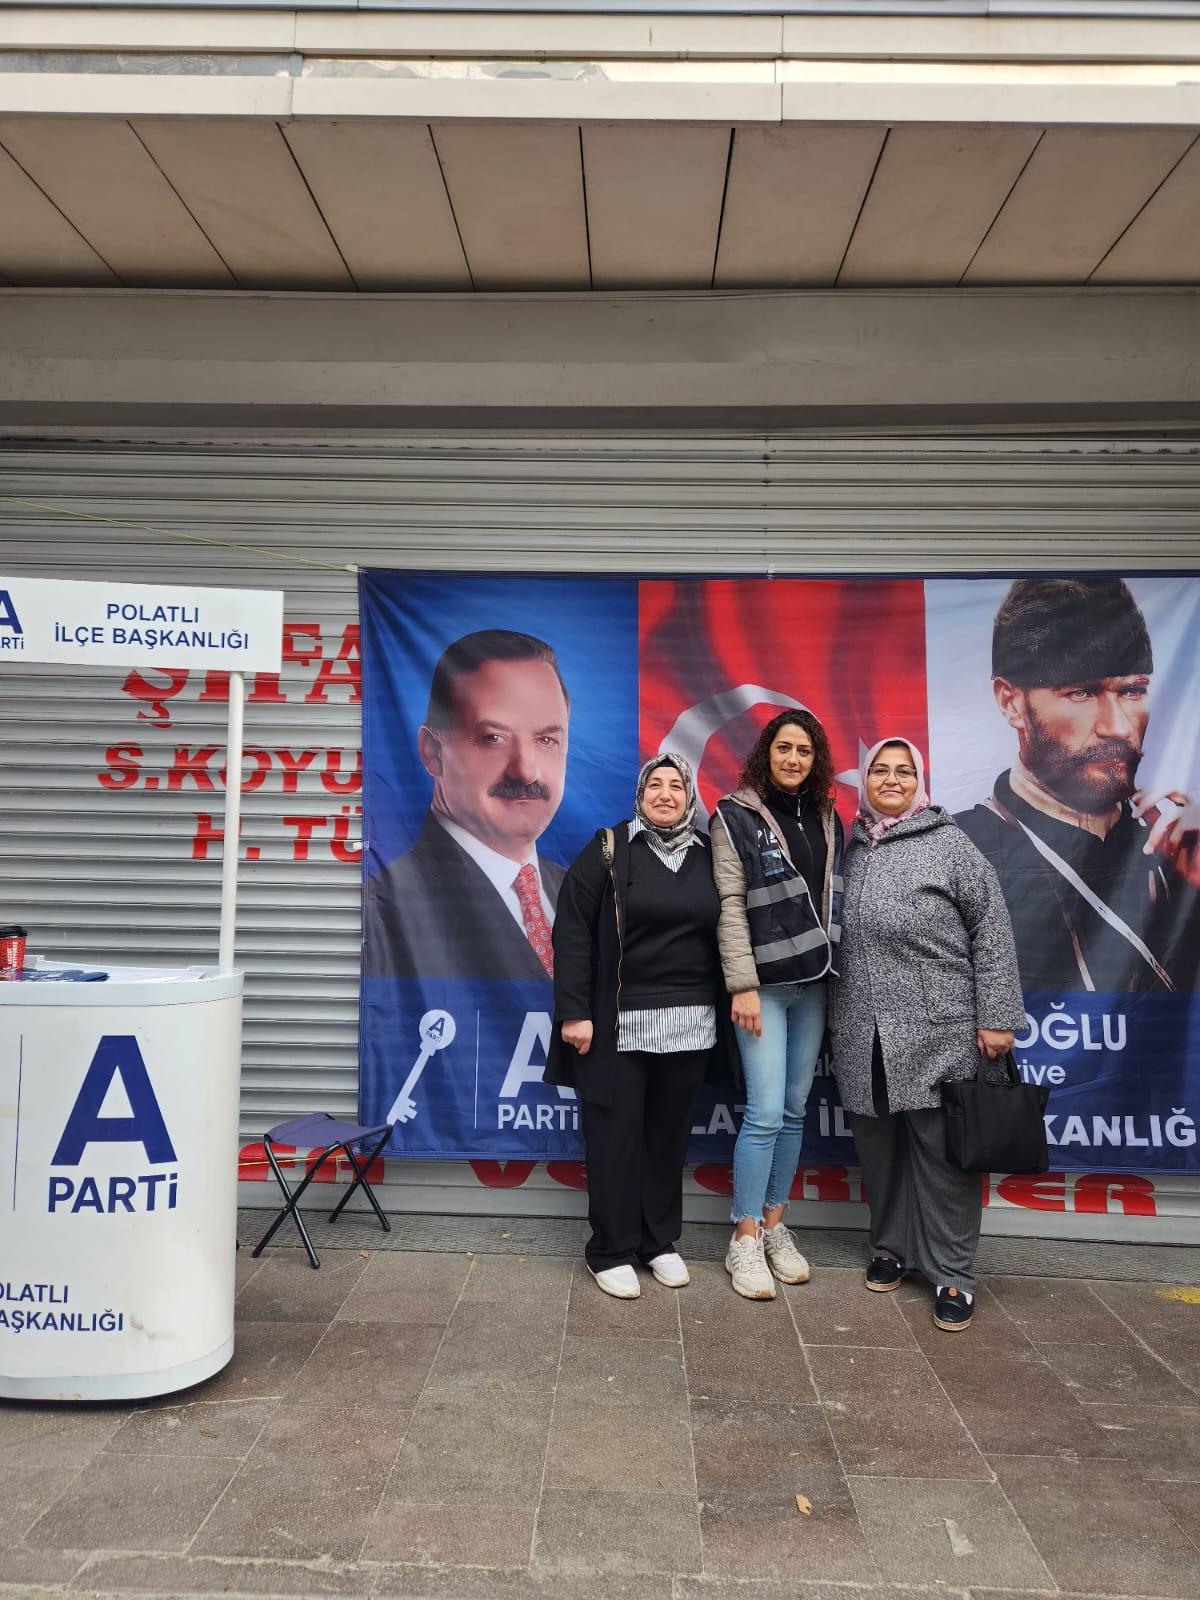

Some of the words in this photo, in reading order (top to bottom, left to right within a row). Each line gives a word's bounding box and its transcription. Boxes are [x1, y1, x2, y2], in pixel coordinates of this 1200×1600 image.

[107, 603, 199, 624] POLATLI
[55, 622, 104, 647] İLÇE
[112, 627, 249, 651] BAŞKANLIĞI
[51, 1035, 178, 1166] A
